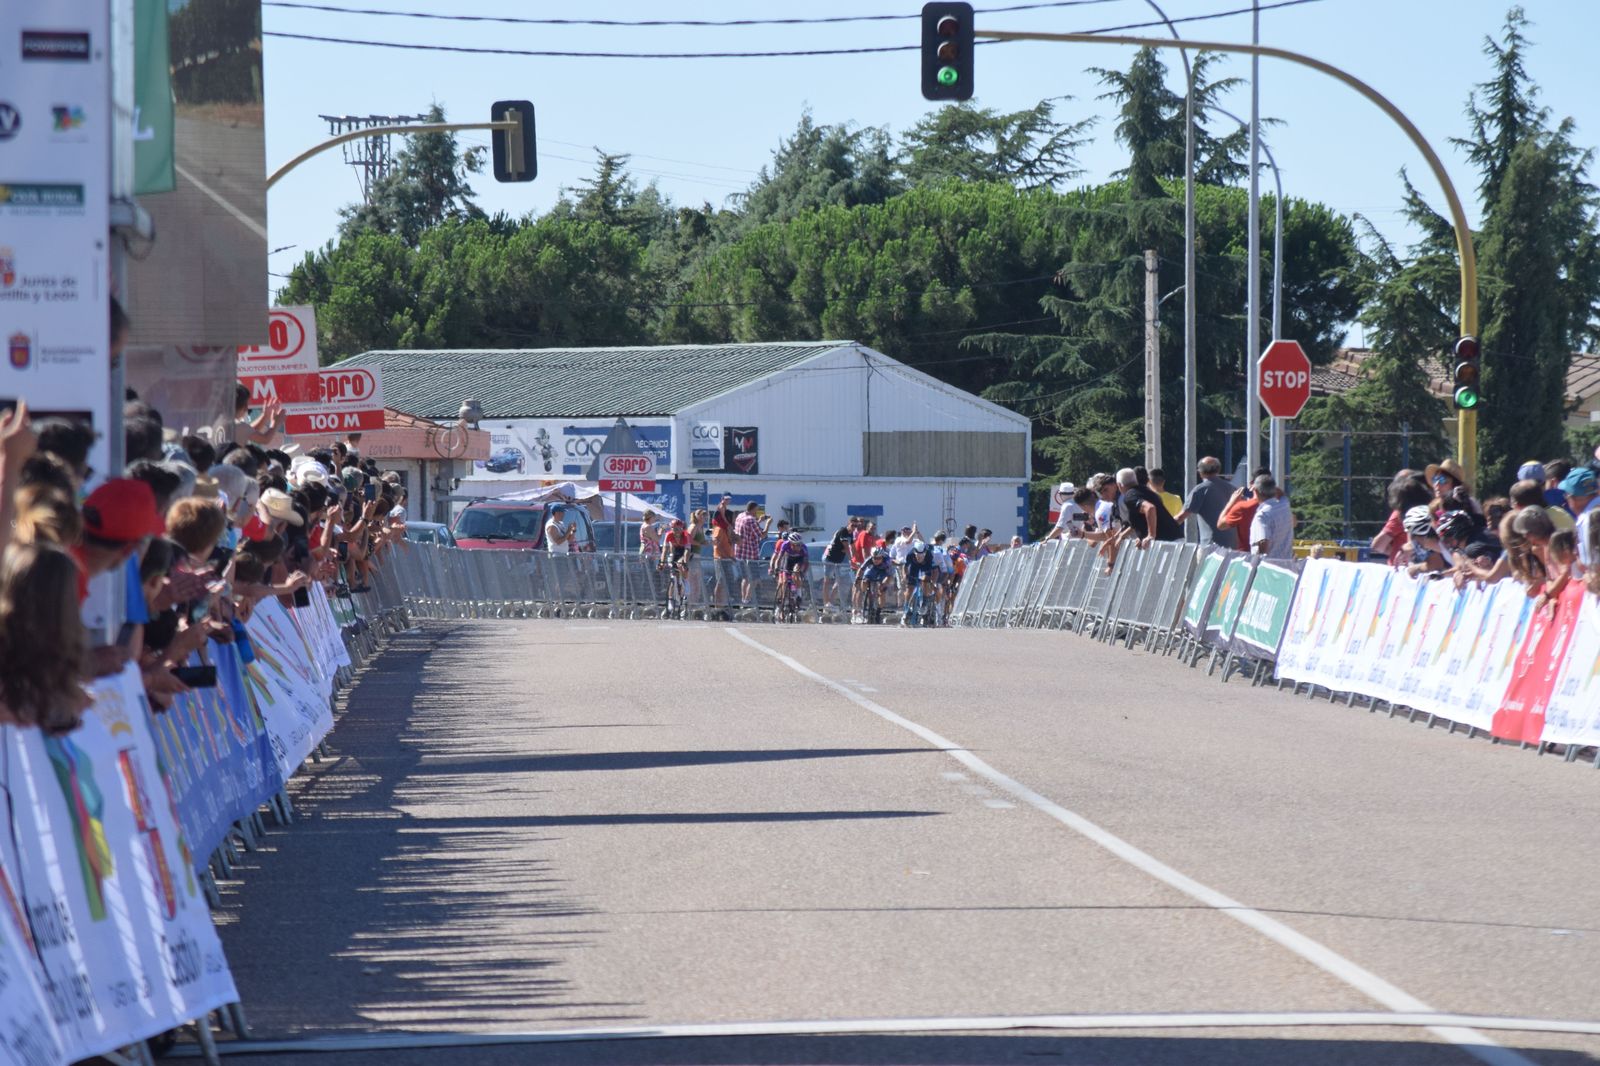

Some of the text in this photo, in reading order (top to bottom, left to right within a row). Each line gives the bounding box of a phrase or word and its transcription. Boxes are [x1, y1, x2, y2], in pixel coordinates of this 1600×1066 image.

[1263, 370, 1308, 388] STOP
[320, 374, 364, 402] spro
[309, 413, 360, 430] 100 M
[609, 458, 646, 474] aspro
[611, 481, 643, 490] 200 M
